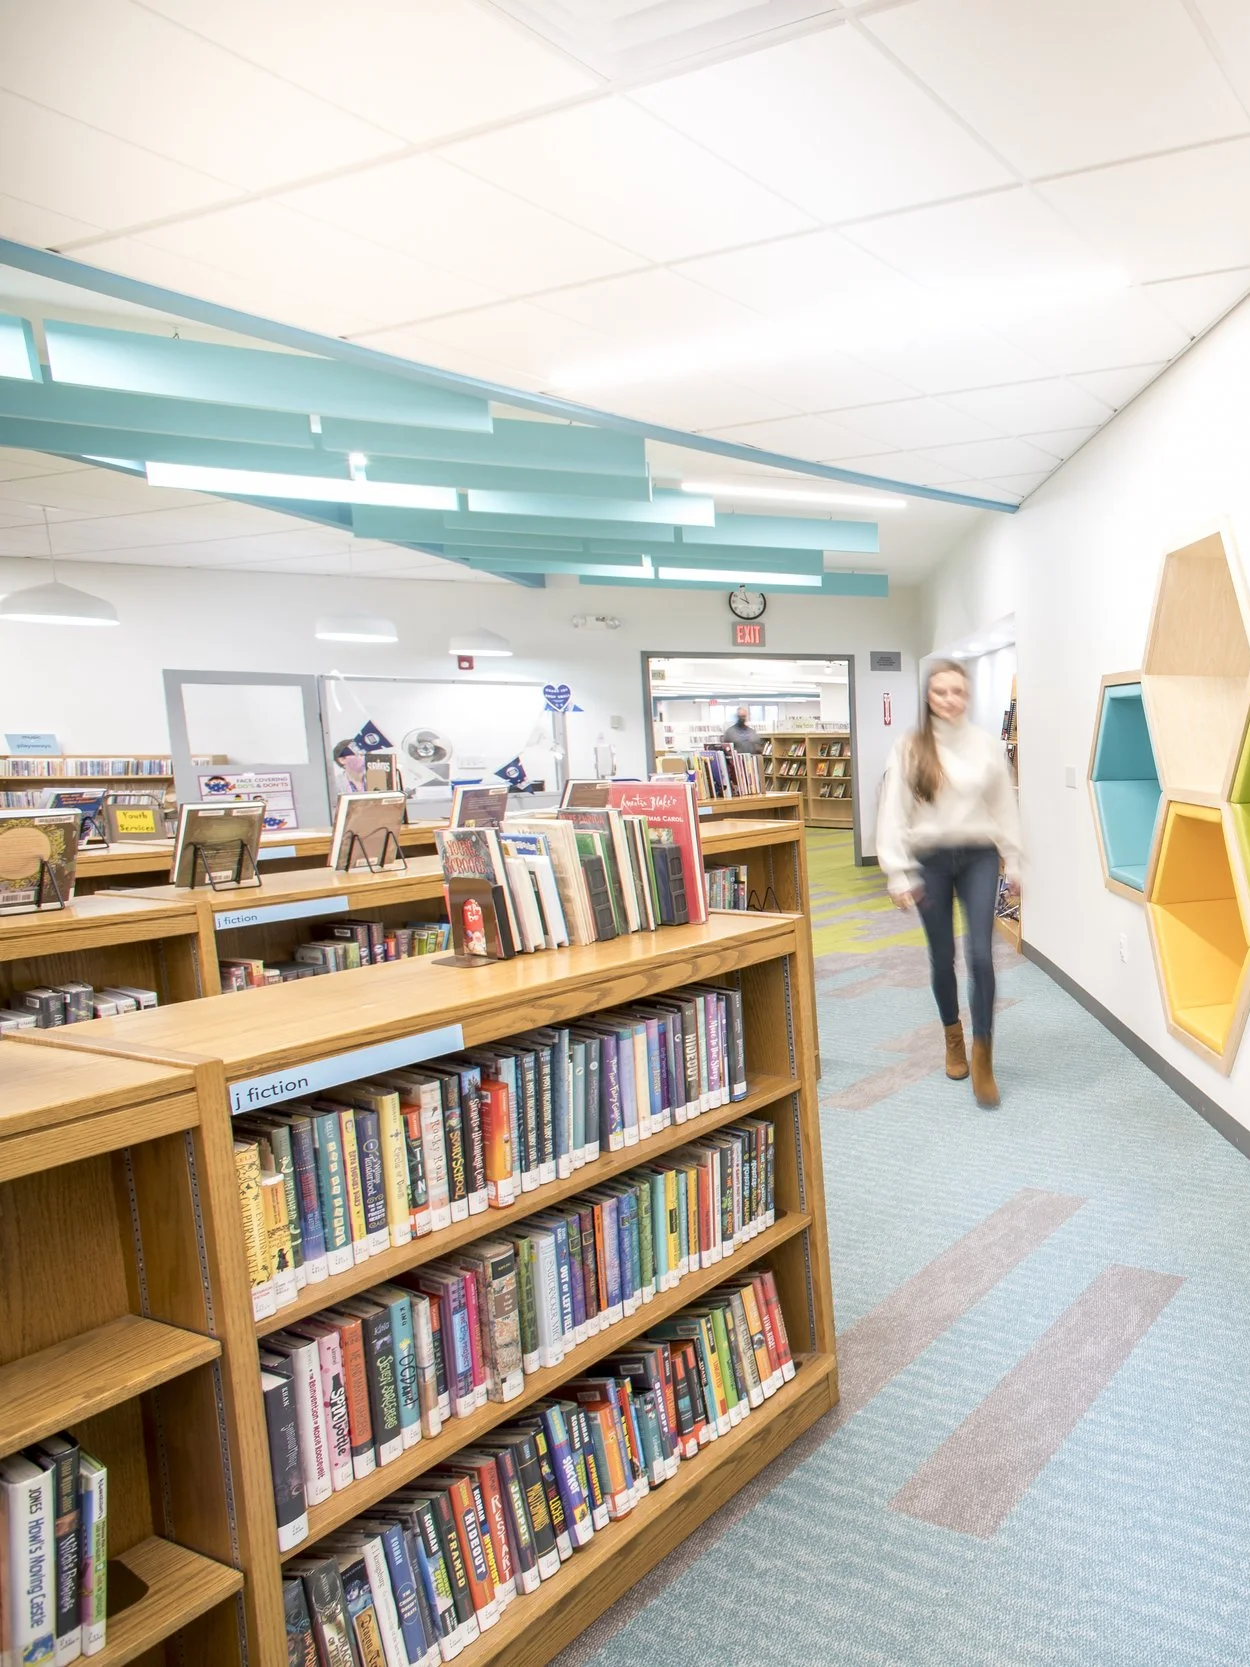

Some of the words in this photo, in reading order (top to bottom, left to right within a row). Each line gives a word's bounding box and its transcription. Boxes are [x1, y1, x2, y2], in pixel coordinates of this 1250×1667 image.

[736, 625, 760, 643] EXIT
[119, 824, 155, 832] Services
[122, 811, 148, 820] Youth
[217, 918, 221, 927] j
[224, 913, 258, 925] fiction
[685, 1033, 698, 1082] HIDEOUT
[235, 1093, 241, 1110] j
[247, 1077, 308, 1103] fiction
[301, 1132, 311, 1161] KELLY
[324, 1120, 334, 1139] KELLY
[431, 1119, 442, 1153] Rocky
[365, 1155, 375, 1196] Tenderfoot
[433, 1155, 446, 1183] Road
[476, 1169, 486, 1192] Castl
[560, 1265, 569, 1283] OUT
[547, 1264, 557, 1321] NUTCRACKER
[562, 1293, 571, 1314] LEFT
[564, 1314, 572, 1333] FIEL
[655, 1382, 668, 1433] SHOWOFF
[571, 1415, 581, 1449] KORMAN
[579, 1412, 589, 1443] KORMAN
[588, 1456, 602, 1505] HYPNOTISTS
[28, 1487, 42, 1515] JONES
[62, 1495, 74, 1513] Jones
[473, 1488, 485, 1522] KORMAN
[511, 1485, 529, 1541] JACKPOT
[526, 1482, 549, 1533] MASTERMINDS
[549, 1496, 564, 1525] LOSER
[28, 1517, 44, 1554] Howl's
[424, 1512, 439, 1553] KORMAN
[464, 1512, 486, 1575] HIDEOUT
[491, 1494, 511, 1582] RESTART
[60, 1533, 78, 1570] Witch's
[391, 1536, 402, 1565] KORMAN
[448, 1531, 466, 1588] FRAMED
[27, 1556, 45, 1594] Moving
[60, 1570, 77, 1614] Business
[30, 1594, 45, 1629] Castle
